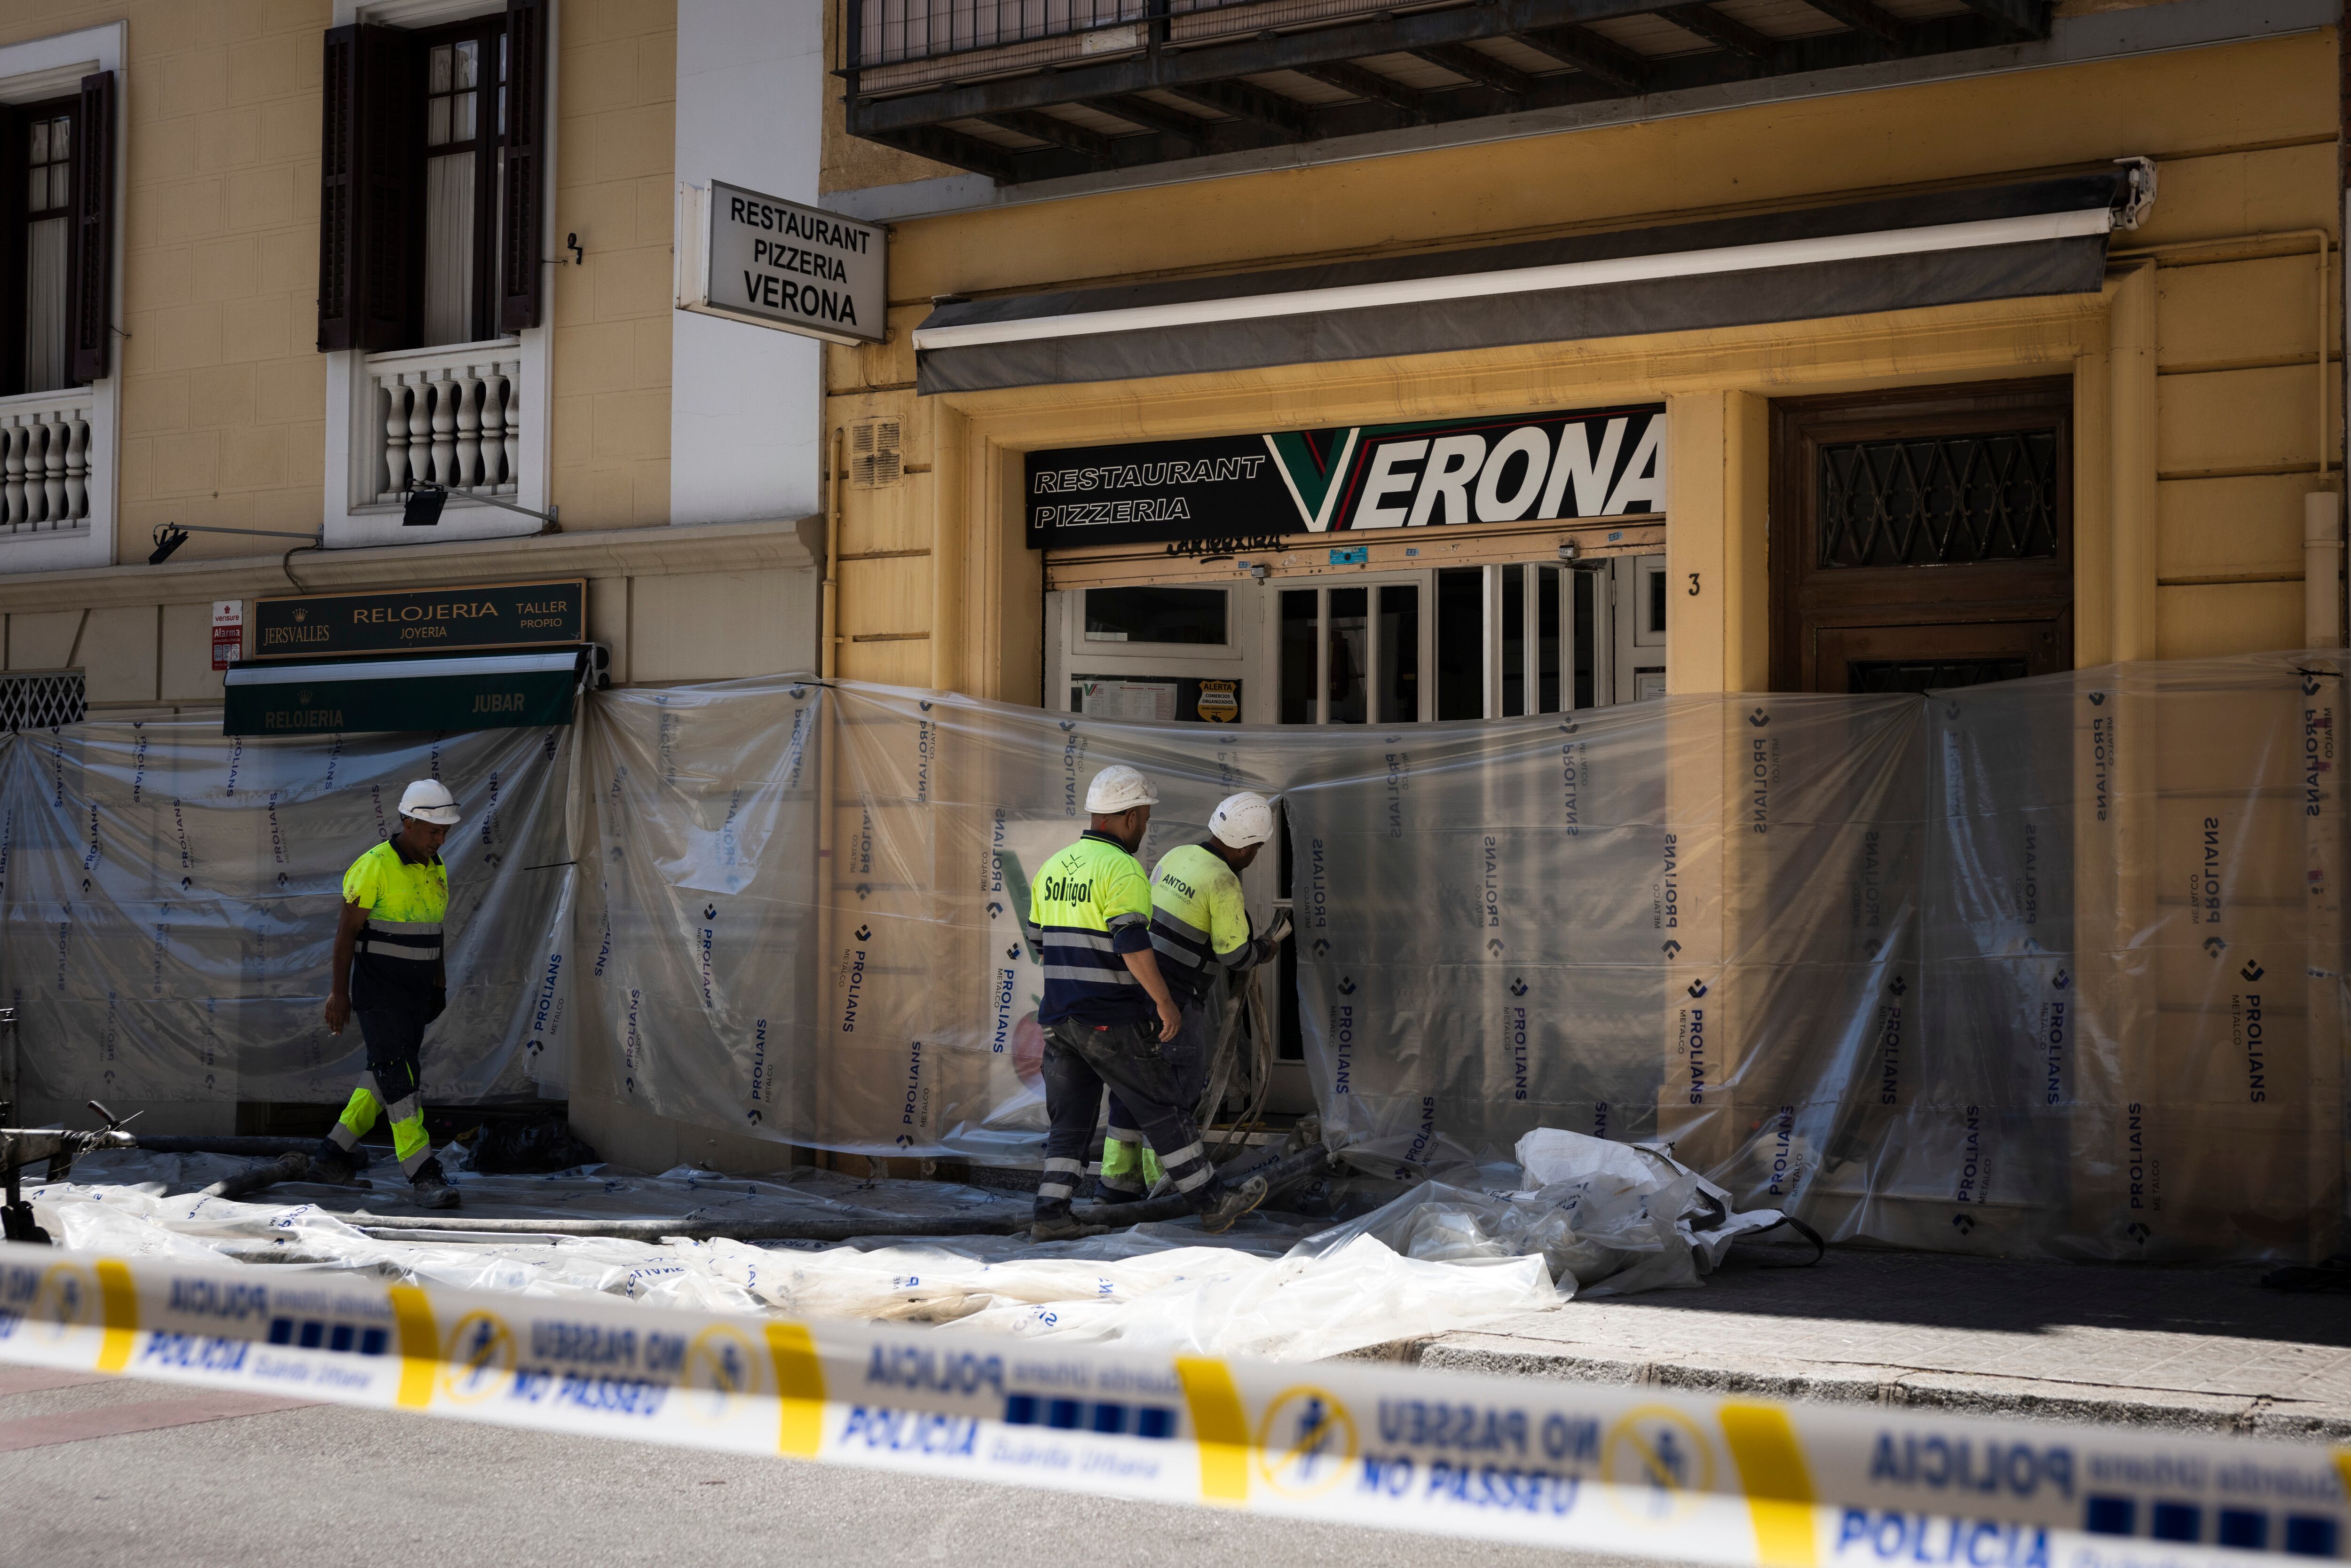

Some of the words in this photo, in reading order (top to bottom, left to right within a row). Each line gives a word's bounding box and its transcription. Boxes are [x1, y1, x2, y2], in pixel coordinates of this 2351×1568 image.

[731, 197, 870, 254] RESTAURANT
[754, 239, 847, 284] PIZZERIA
[744, 270, 857, 325] VERONA
[1034, 456, 1265, 494] RESTAURANT
[1262, 414, 1665, 532] VERONA
[1035, 497, 1191, 528] PIZZERIA
[354, 602, 498, 623] RELOJERIA
[516, 601, 567, 615] TALLER
[1688, 573, 1700, 596] 3
[214, 628, 240, 638] Alarma
[264, 625, 330, 646] JERSVALLES
[400, 627, 447, 639] JOYERIA
[521, 618, 562, 629] PROPIO
[265, 709, 344, 729] RELOJERIA
[472, 693, 524, 713] JUBAR
[134, 736, 147, 804] PROLIANS
[227, 734, 242, 797] ROLIANS
[325, 732, 342, 790] ROLIANS
[431, 729, 446, 780] OLIANS
[84, 804, 98, 870] PROLIANS
[174, 799, 189, 868] PROLIANS
[269, 793, 284, 864] PROLIANS
[372, 784, 390, 843] OLIANS
[280, 830, 291, 864] METALCO
[1162, 874, 1196, 899] ANTON
[600, 902, 608, 934] ETALCO
[535, 954, 562, 1031] PROLIANS
[703, 929, 713, 1009] PROLIANS
[839, 948, 851, 988] METALCO
[842, 951, 866, 1033] PROLIANS
[994, 968, 1003, 1009] METALCO
[550, 998, 564, 1035] METALCO
[626, 989, 640, 1068] PROLIANS
[993, 969, 1015, 1054] PROLIANS
[2040, 1002, 2049, 1050] METALCO
[2232, 994, 2242, 1046] METALCO
[752, 1019, 767, 1100] PROLIANS
[1336, 1006, 1353, 1094] PROLIANS
[1514, 1008, 1527, 1100] PROLIANS
[1689, 1010, 1704, 1105] PROLIANS
[1882, 1007, 1902, 1105] PROLIANS
[2048, 1002, 2065, 1105] PROLIANS
[2246, 994, 2265, 1103] PROLIANS
[903, 1041, 922, 1125] PROLIANS
[920, 1087, 930, 1128] METALCO
[1404, 1096, 1434, 1162] PROLIANS
[1422, 1142, 1439, 1168] METALCO
[1769, 1105, 1794, 1196] PROLIANS
[1957, 1104, 1980, 1202] PROLIANS
[2129, 1102, 2144, 1209] PROLIANS
[1792, 1153, 1803, 1197] METALCO
[1978, 1158, 1992, 1205] METALCO
[2152, 1160, 2161, 1212] METALCO
[840, 1405, 978, 1457] POLICIA
[1359, 1458, 1411, 1498] NO
[1425, 1464, 1582, 1516] PASSEU
[1837, 1507, 2052, 1568] POLICIA
